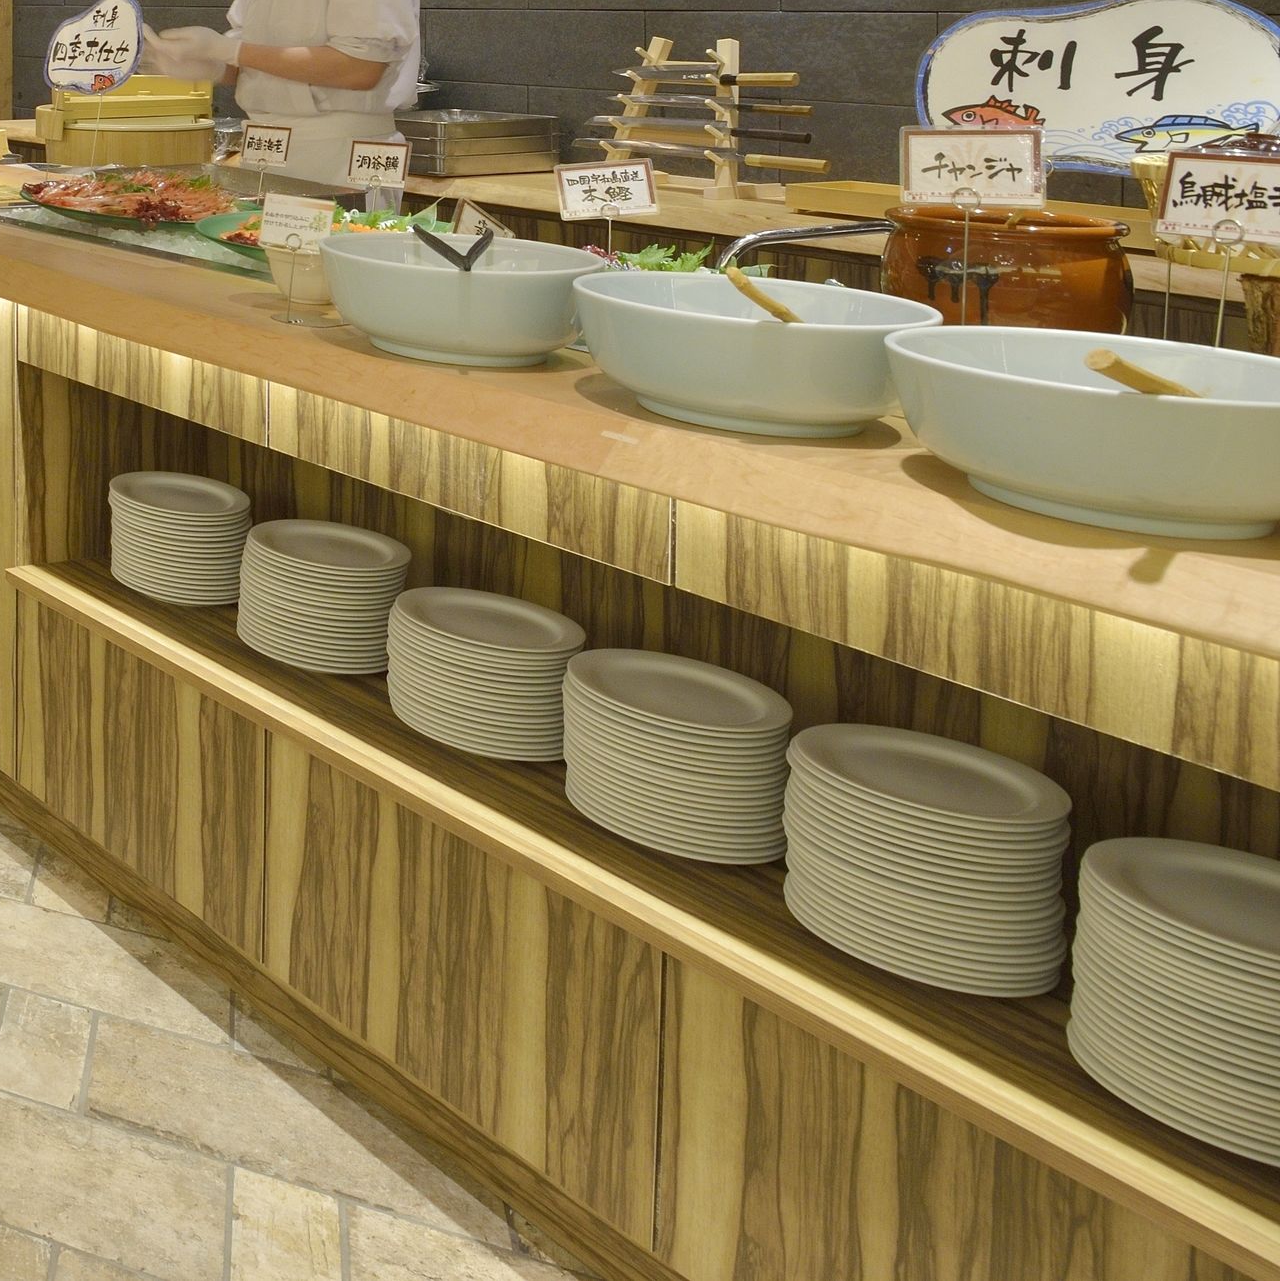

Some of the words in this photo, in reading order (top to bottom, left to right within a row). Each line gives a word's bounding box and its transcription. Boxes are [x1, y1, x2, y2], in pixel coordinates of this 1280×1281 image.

[93, 5, 120, 28] 刺身
[990, 25, 1195, 102] 刺身
[921, 152, 1023, 182] チャンジャ
